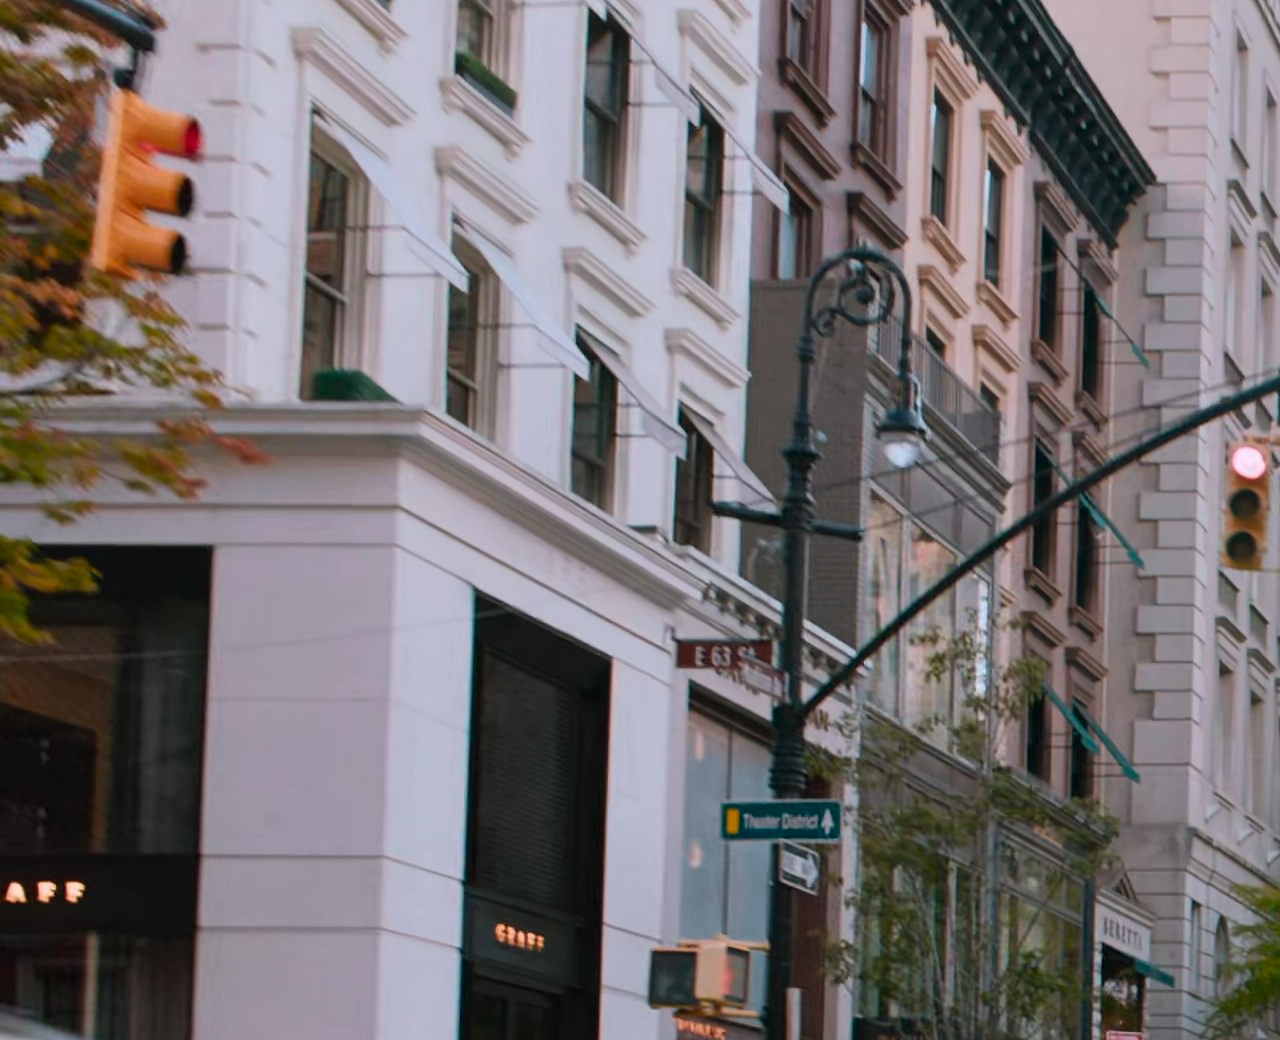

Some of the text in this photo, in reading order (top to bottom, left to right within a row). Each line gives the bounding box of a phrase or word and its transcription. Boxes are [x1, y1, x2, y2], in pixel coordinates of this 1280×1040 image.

[694, 645, 707, 668] E
[711, 644, 731, 668] 63
[743, 812, 819, 830] Theater District
[494, 922, 546, 953] GRAFF
